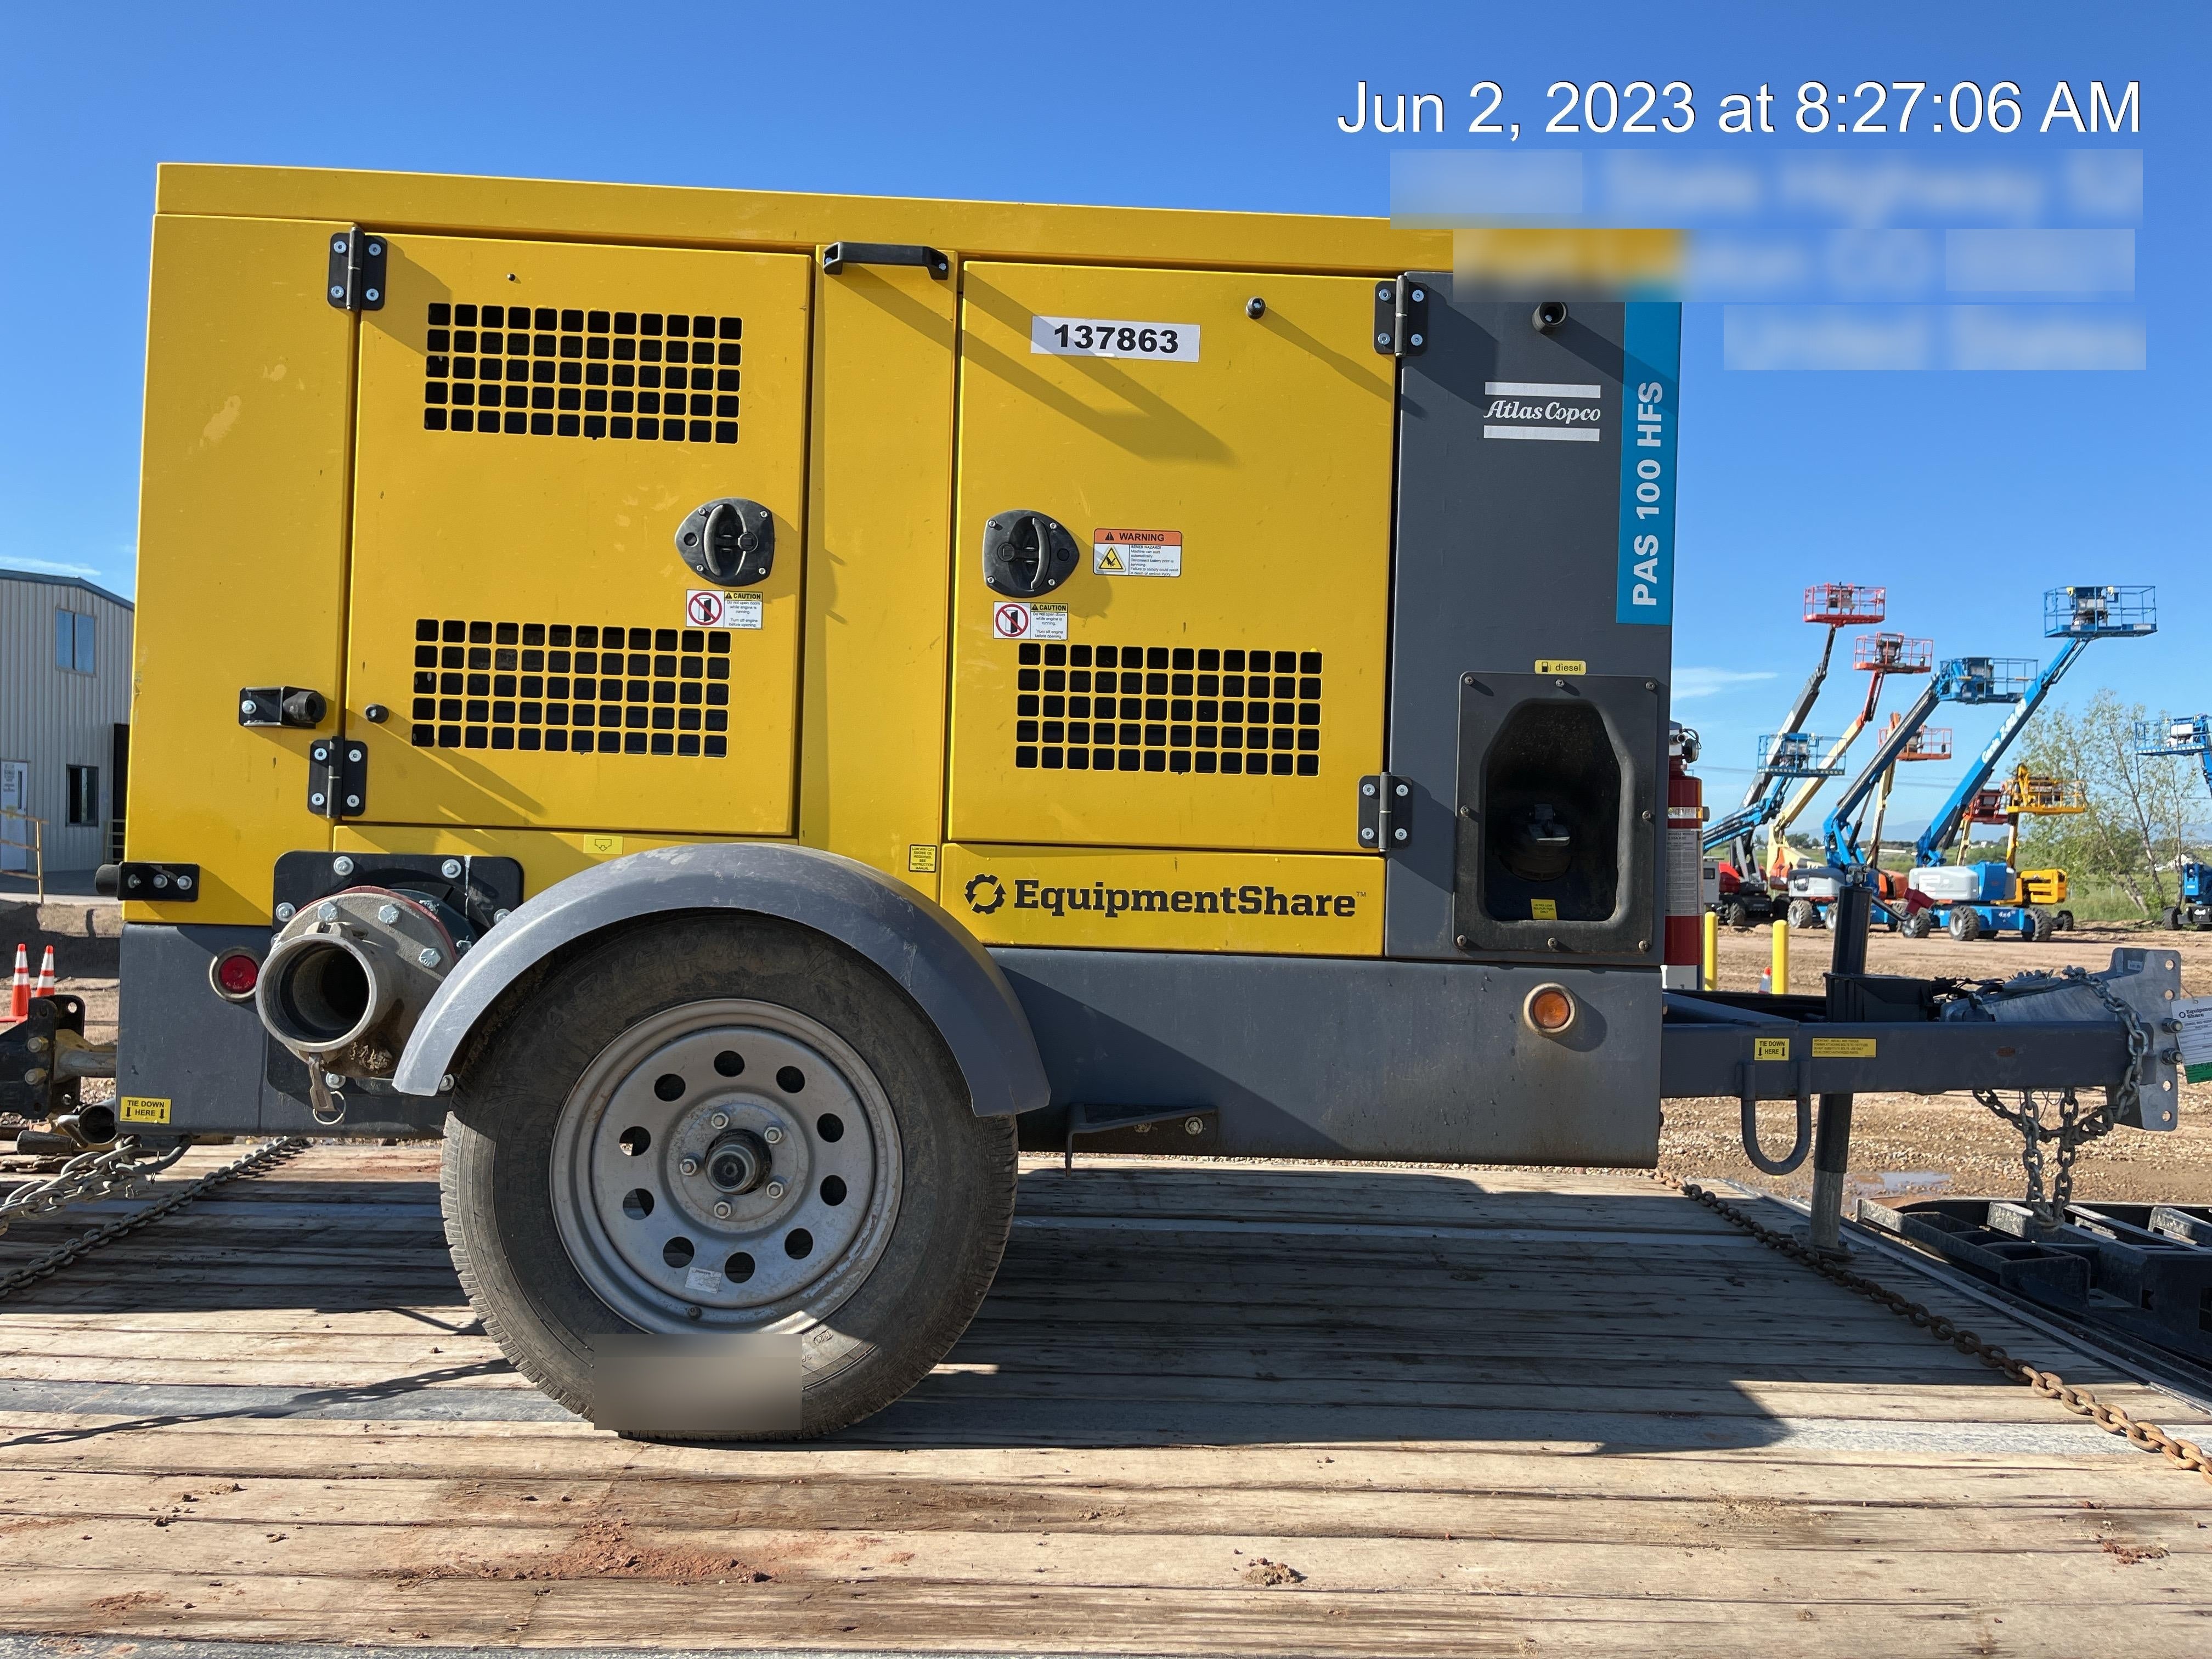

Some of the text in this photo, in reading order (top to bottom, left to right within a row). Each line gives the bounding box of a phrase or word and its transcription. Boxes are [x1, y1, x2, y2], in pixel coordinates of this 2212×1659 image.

[1054, 324, 1179, 354] 137863
[1483, 400, 1601, 424] Atlas Copco
[1632, 381, 1663, 606] PAS 100 HFS
[1119, 532, 1165, 542] WARNING
[1555, 663, 1581, 672] diesel
[1013, 878, 1356, 918] EquipmentShare
